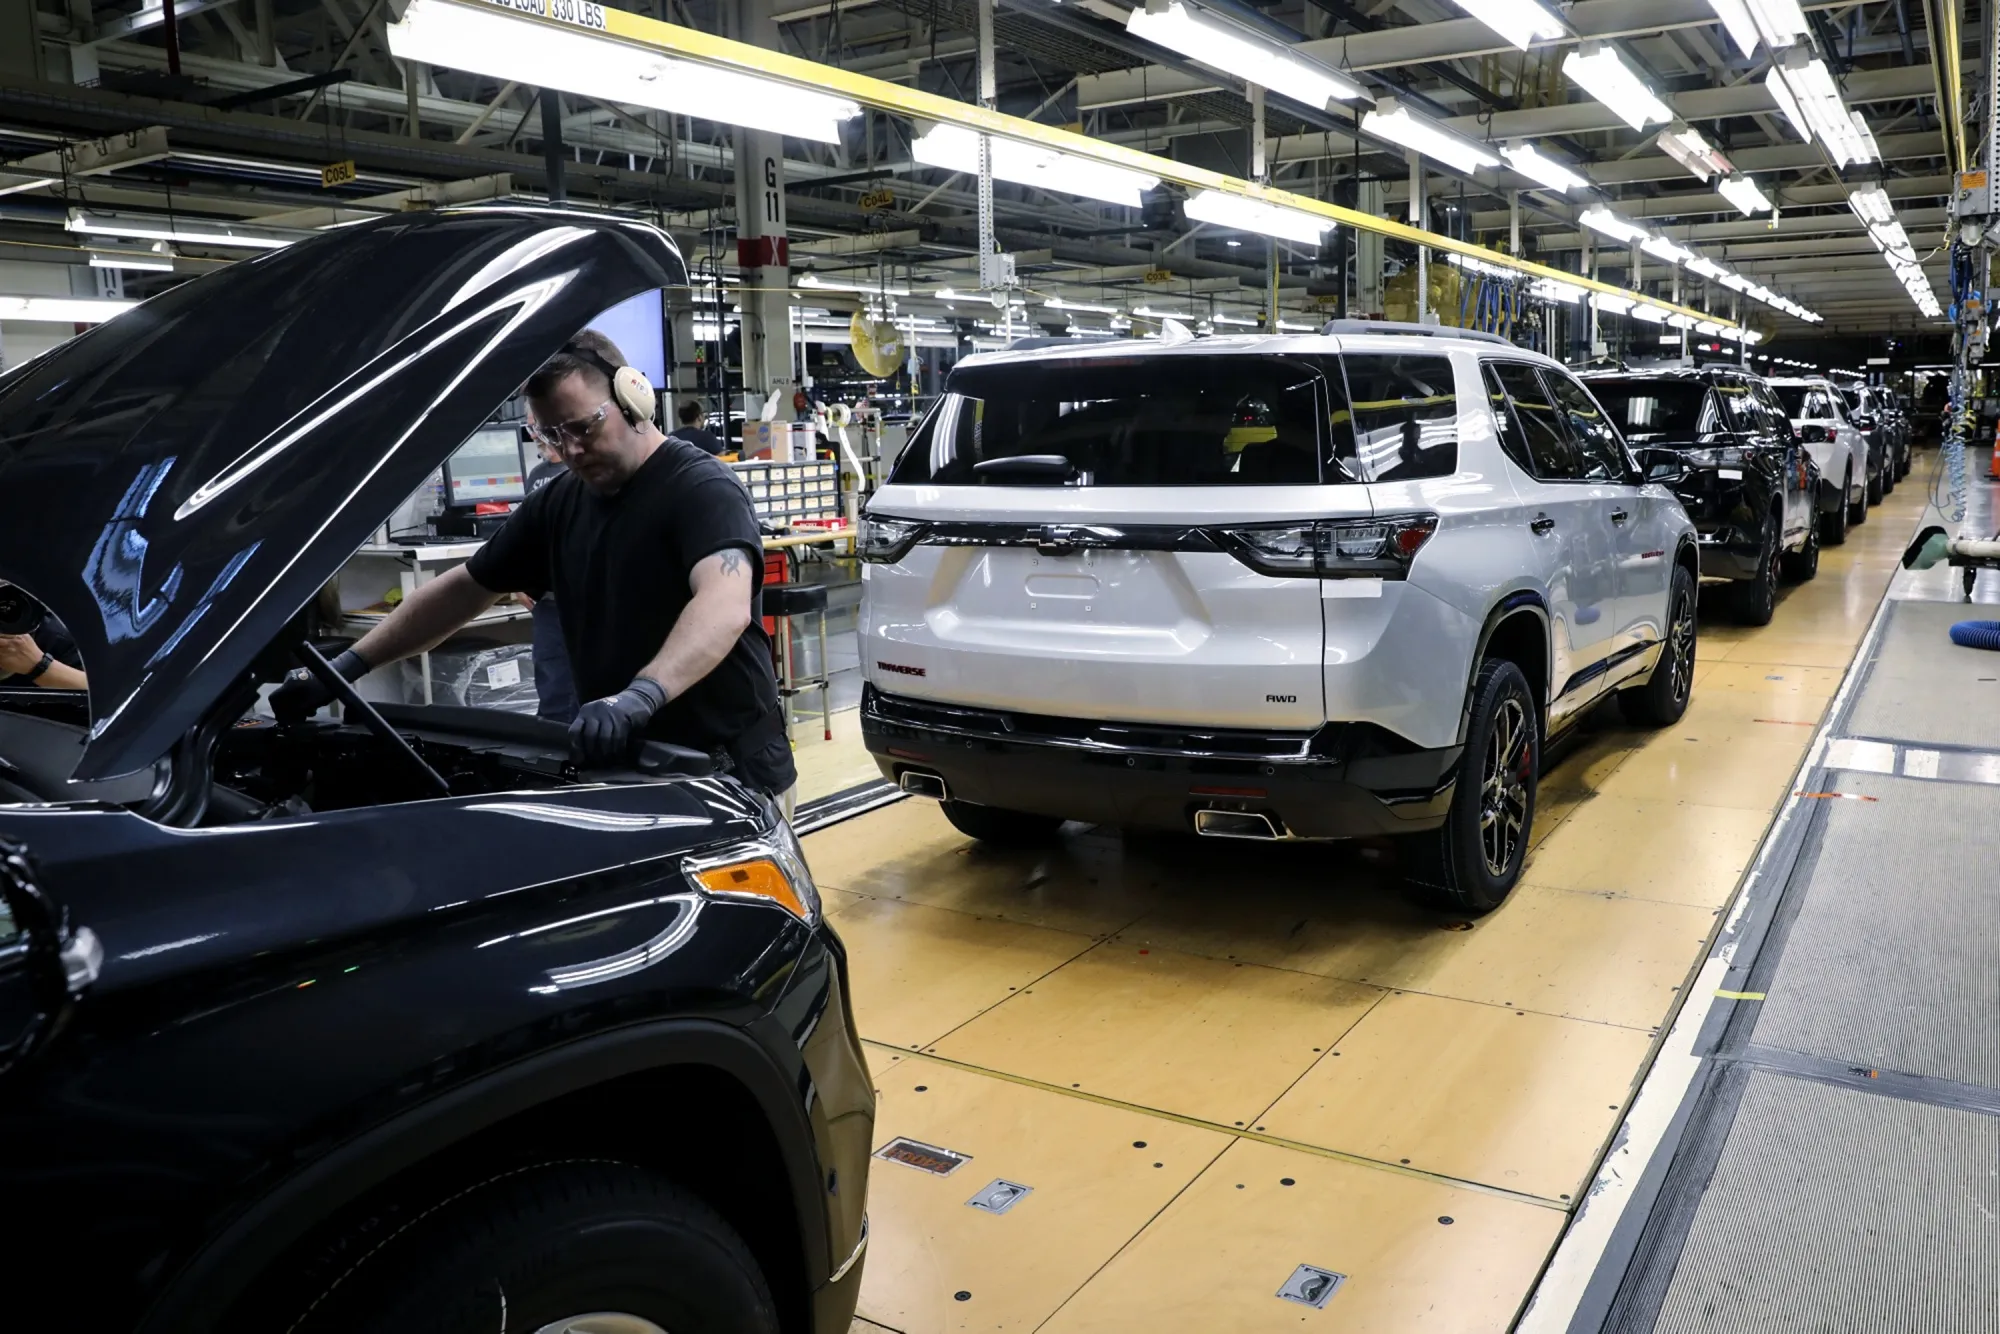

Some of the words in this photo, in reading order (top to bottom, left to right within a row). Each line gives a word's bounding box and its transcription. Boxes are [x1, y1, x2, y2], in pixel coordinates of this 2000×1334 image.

[552, 0, 574, 21] 330
[578, 1, 606, 29] LBS.
[326, 163, 352, 183] C05L
[765, 157, 776, 188] G
[766, 191, 779, 222] 11
[864, 191, 890, 207] C04L
[102, 268, 116, 288] 11
[1266, 694, 1297, 703] AWD
